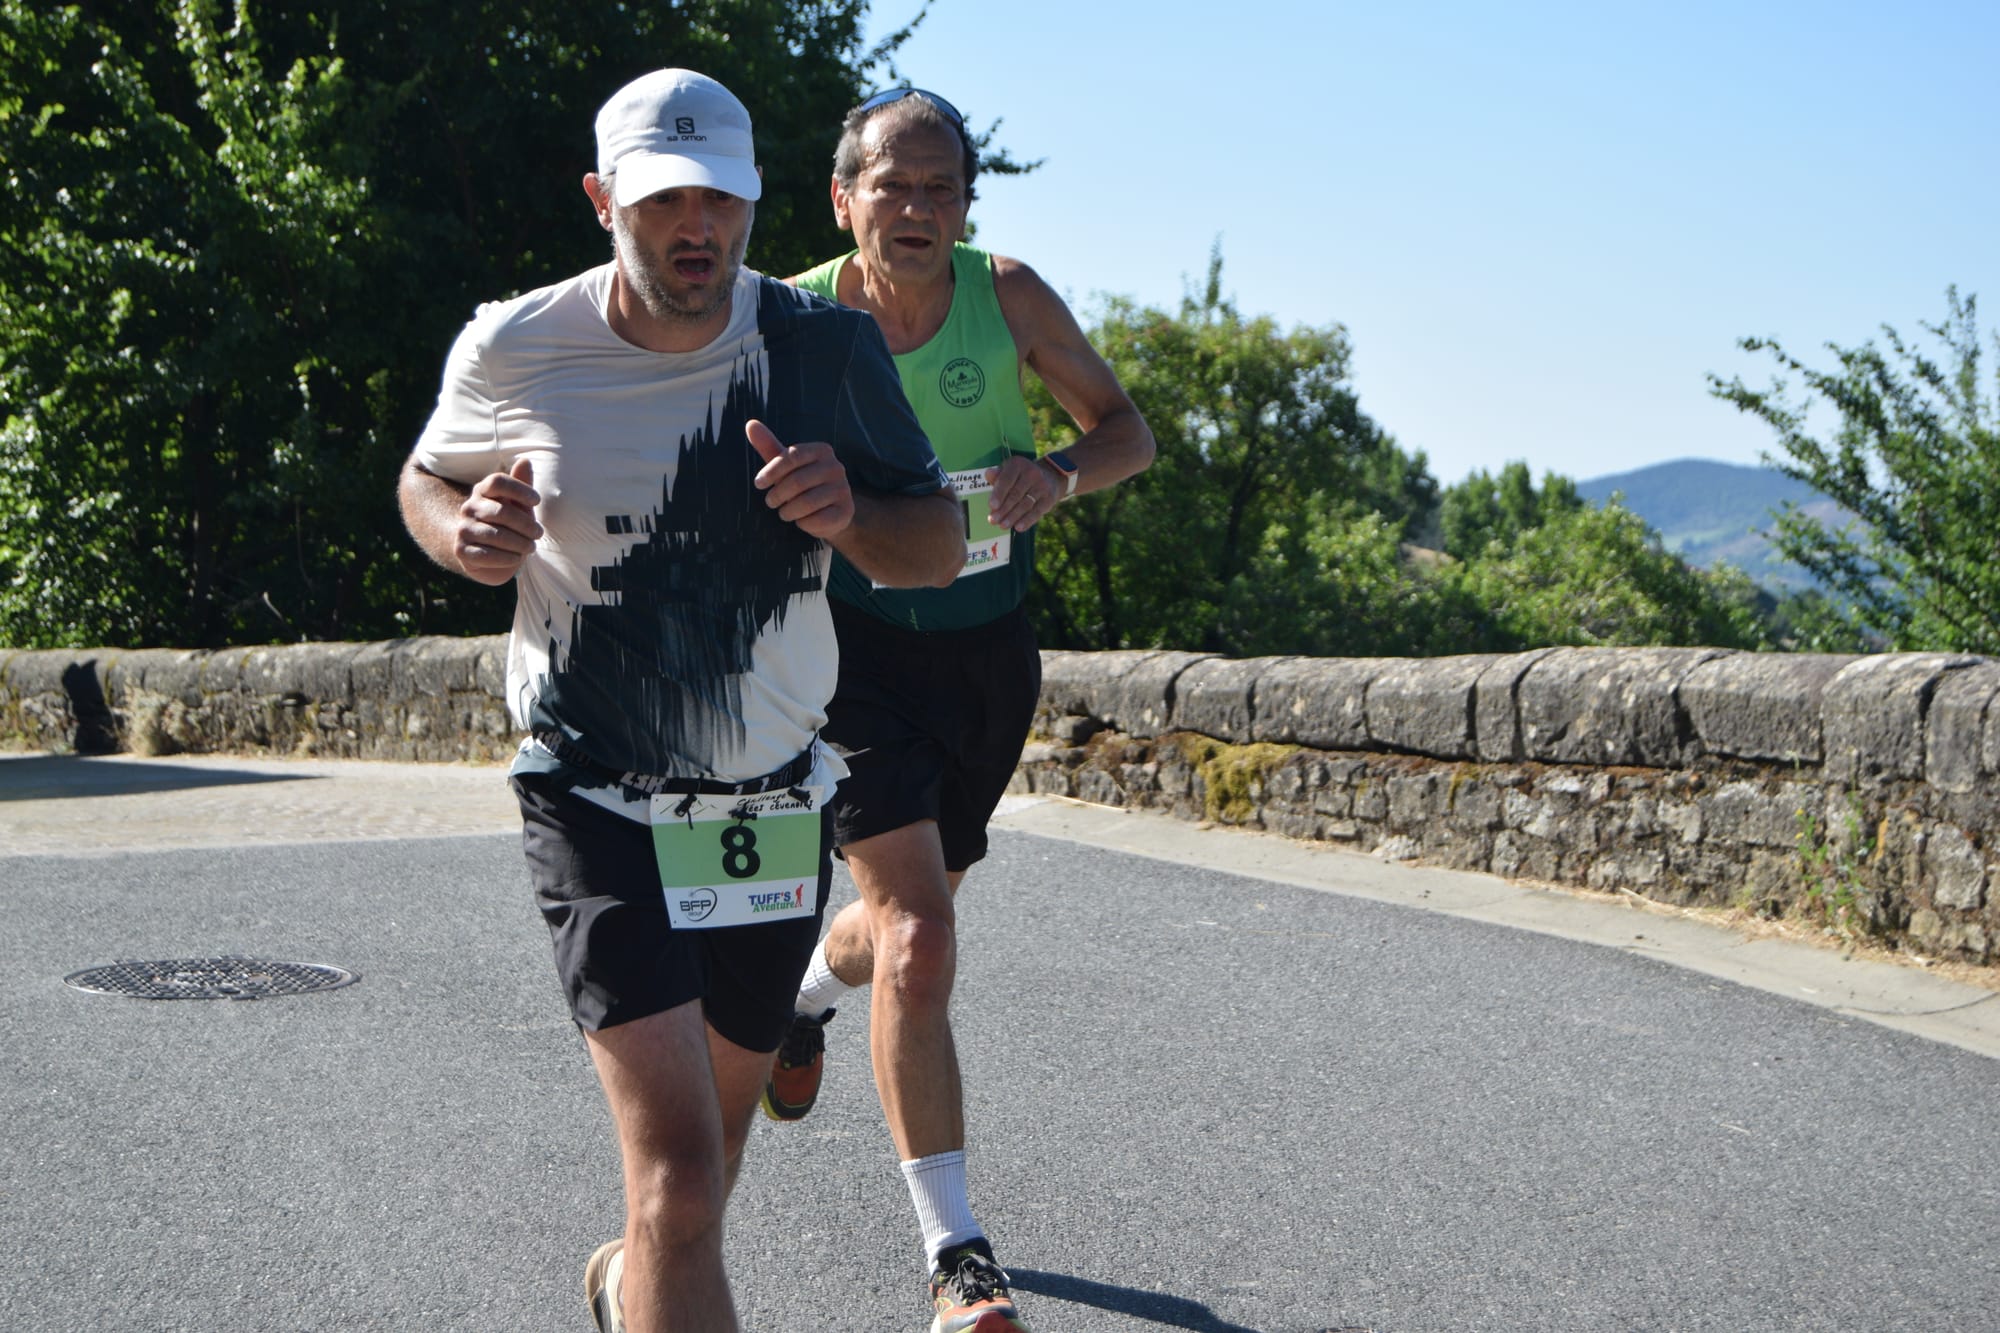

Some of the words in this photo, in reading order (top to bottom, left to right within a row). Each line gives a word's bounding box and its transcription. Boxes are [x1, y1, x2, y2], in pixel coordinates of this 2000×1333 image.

[950, 473, 982, 483] allenge
[720, 825, 761, 879] 8
[748, 891, 792, 906] TUFF'S
[679, 899, 712, 913] BFP
[752, 901, 795, 913] Aventure
